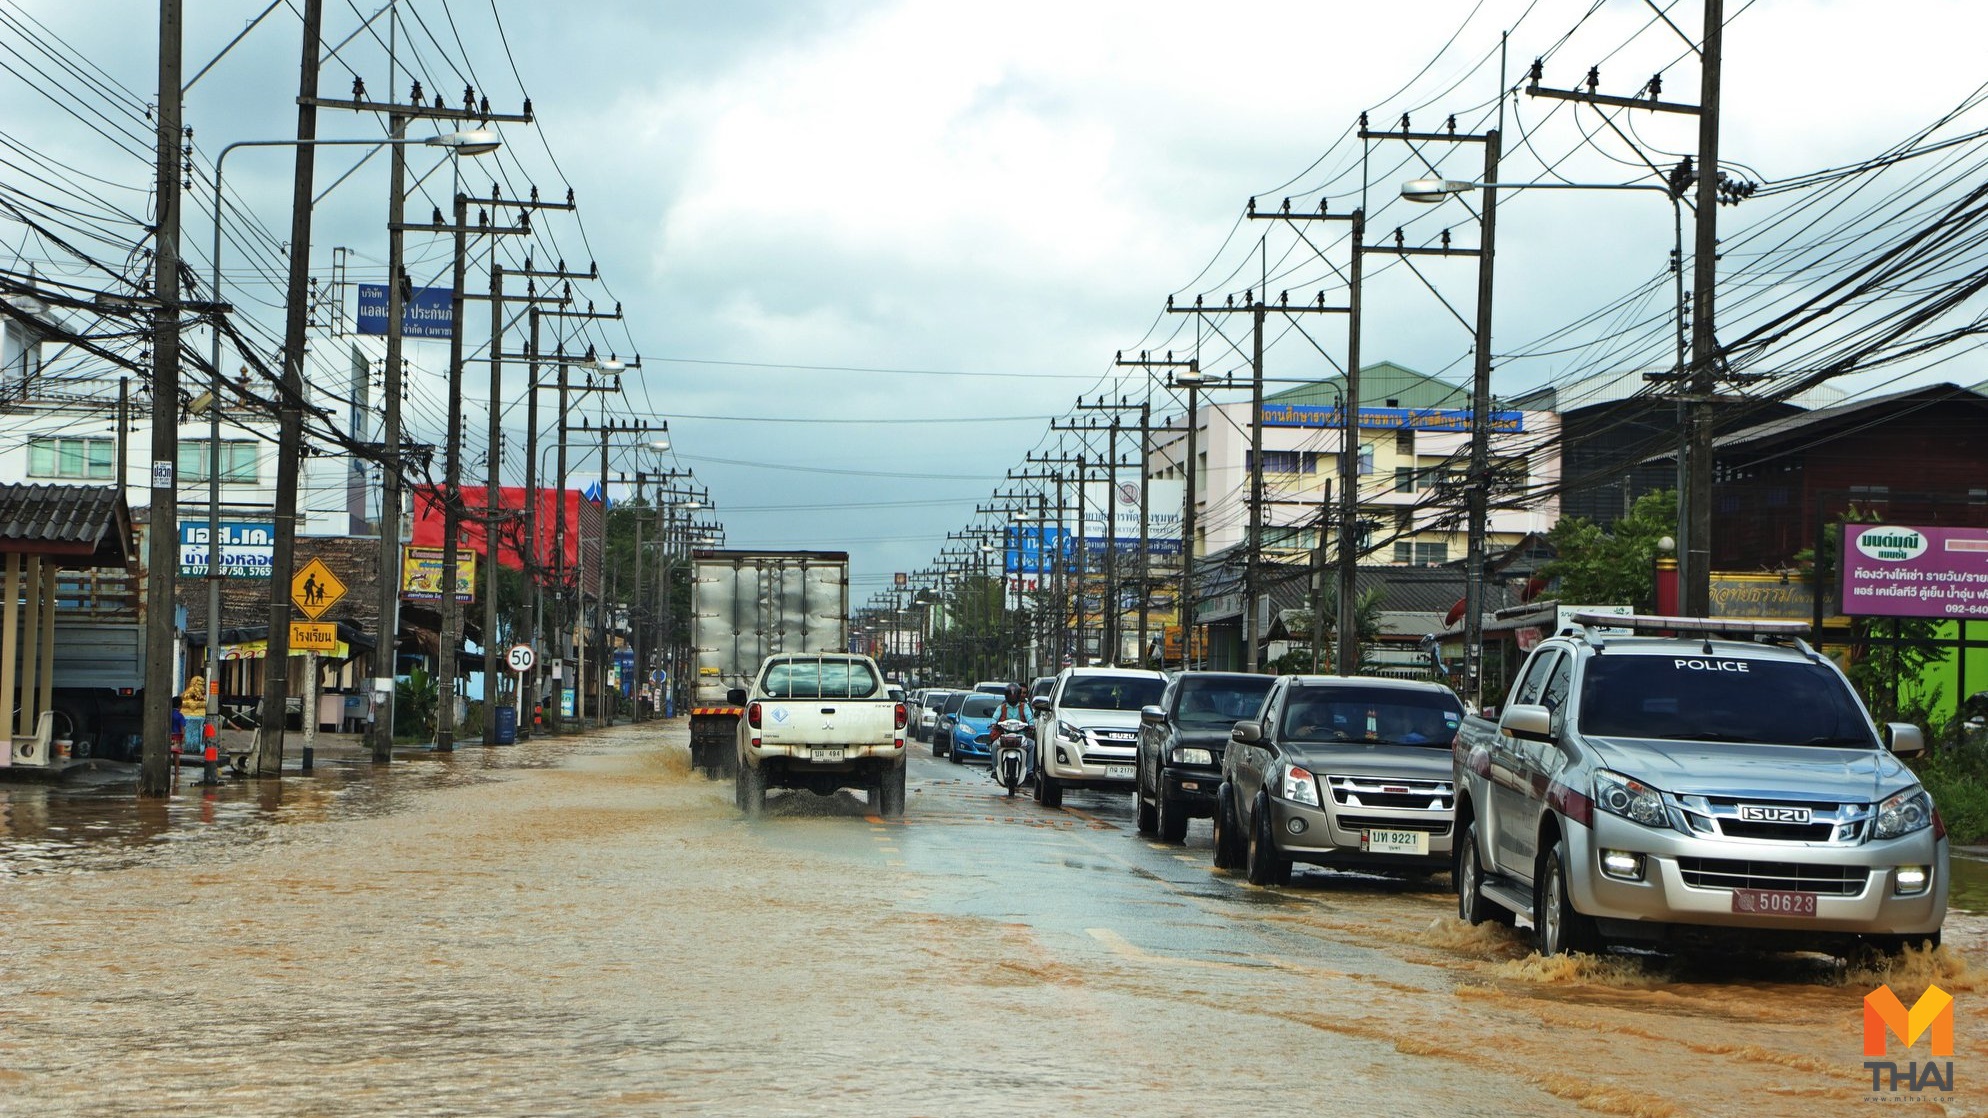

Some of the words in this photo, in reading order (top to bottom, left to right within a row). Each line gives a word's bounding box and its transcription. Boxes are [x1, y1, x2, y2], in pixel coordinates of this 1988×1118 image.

[361, 288, 383, 298] บริษัท
[403, 323, 423, 335] จำกัด
[154, 466, 172, 478] ปลวก
[1854, 567, 1923, 581] ห้องว่างให้เช่า
[1854, 585, 1873, 596] แอร์
[1919, 586, 1944, 601] ตู้เย็น
[1947, 584, 1974, 602] น้ำอุ่น
[293, 627, 332, 642] โรงเรียน
[511, 650, 531, 666] 50
[1674, 659, 1750, 673] POLICE
[1743, 807, 1808, 823] ISUZU
[1373, 832, 1388, 843] บท
[1391, 833, 1417, 844] 9221
[1760, 893, 1814, 913] 50623
